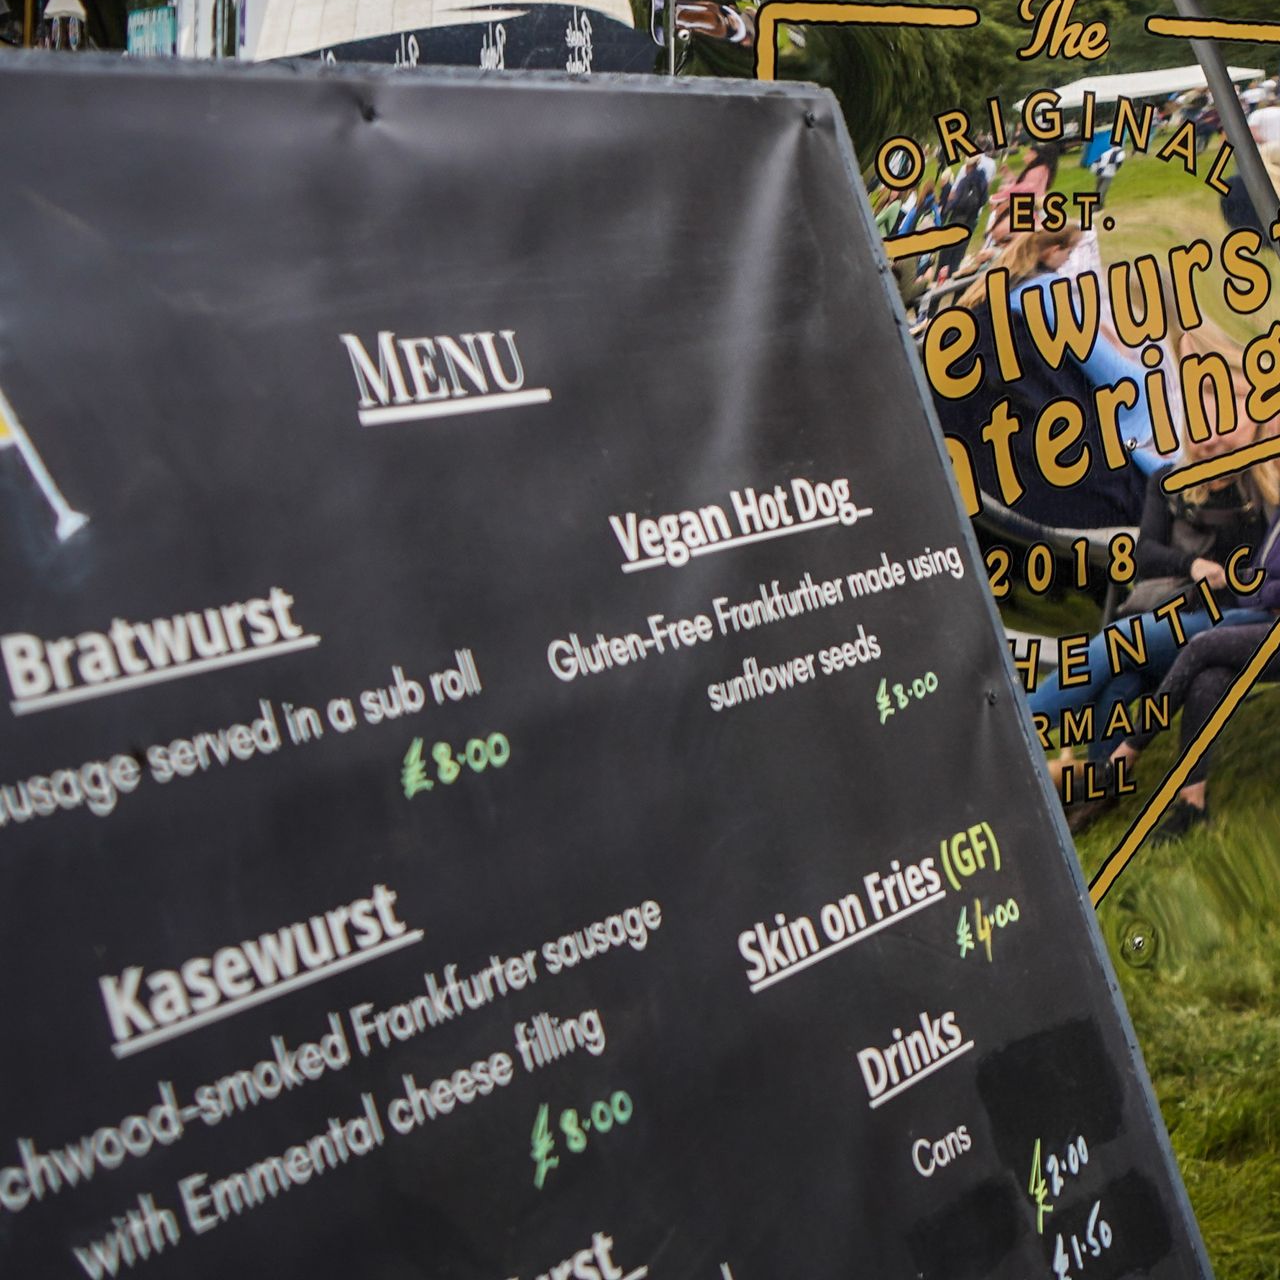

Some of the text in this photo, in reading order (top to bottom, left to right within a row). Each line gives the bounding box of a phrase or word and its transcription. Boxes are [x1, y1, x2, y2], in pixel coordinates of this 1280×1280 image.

[874, 89, 1238, 198] ORIGINAL
[1009, 192, 1116, 234] EST.
[339, 330, 526, 408] MENU
[609, 476, 861, 568] Vegan Hot Dog
[985, 533, 1137, 598] 2018
[1, 586, 303, 699] Bratwurst
[547, 542, 966, 683] Gluten-Free Frankfurther made using
[147, 700, 281, 783] served
[284, 703, 324, 746] in
[327, 699, 358, 734] a
[361, 666, 425, 724] sub
[430, 649, 483, 706] roll
[707, 625, 883, 713] sunflower seeds
[738, 821, 1002, 987] Skin on Fries (GF)
[99, 883, 408, 1041] Kasewurst
[349, 955, 539, 1056] Frankfurter
[541, 899, 664, 974] sausage
[856, 1008, 964, 1099] Drinks
[73, 1008, 607, 1280] with Emmental cheese filling
[912, 1124, 972, 1178] Cans
